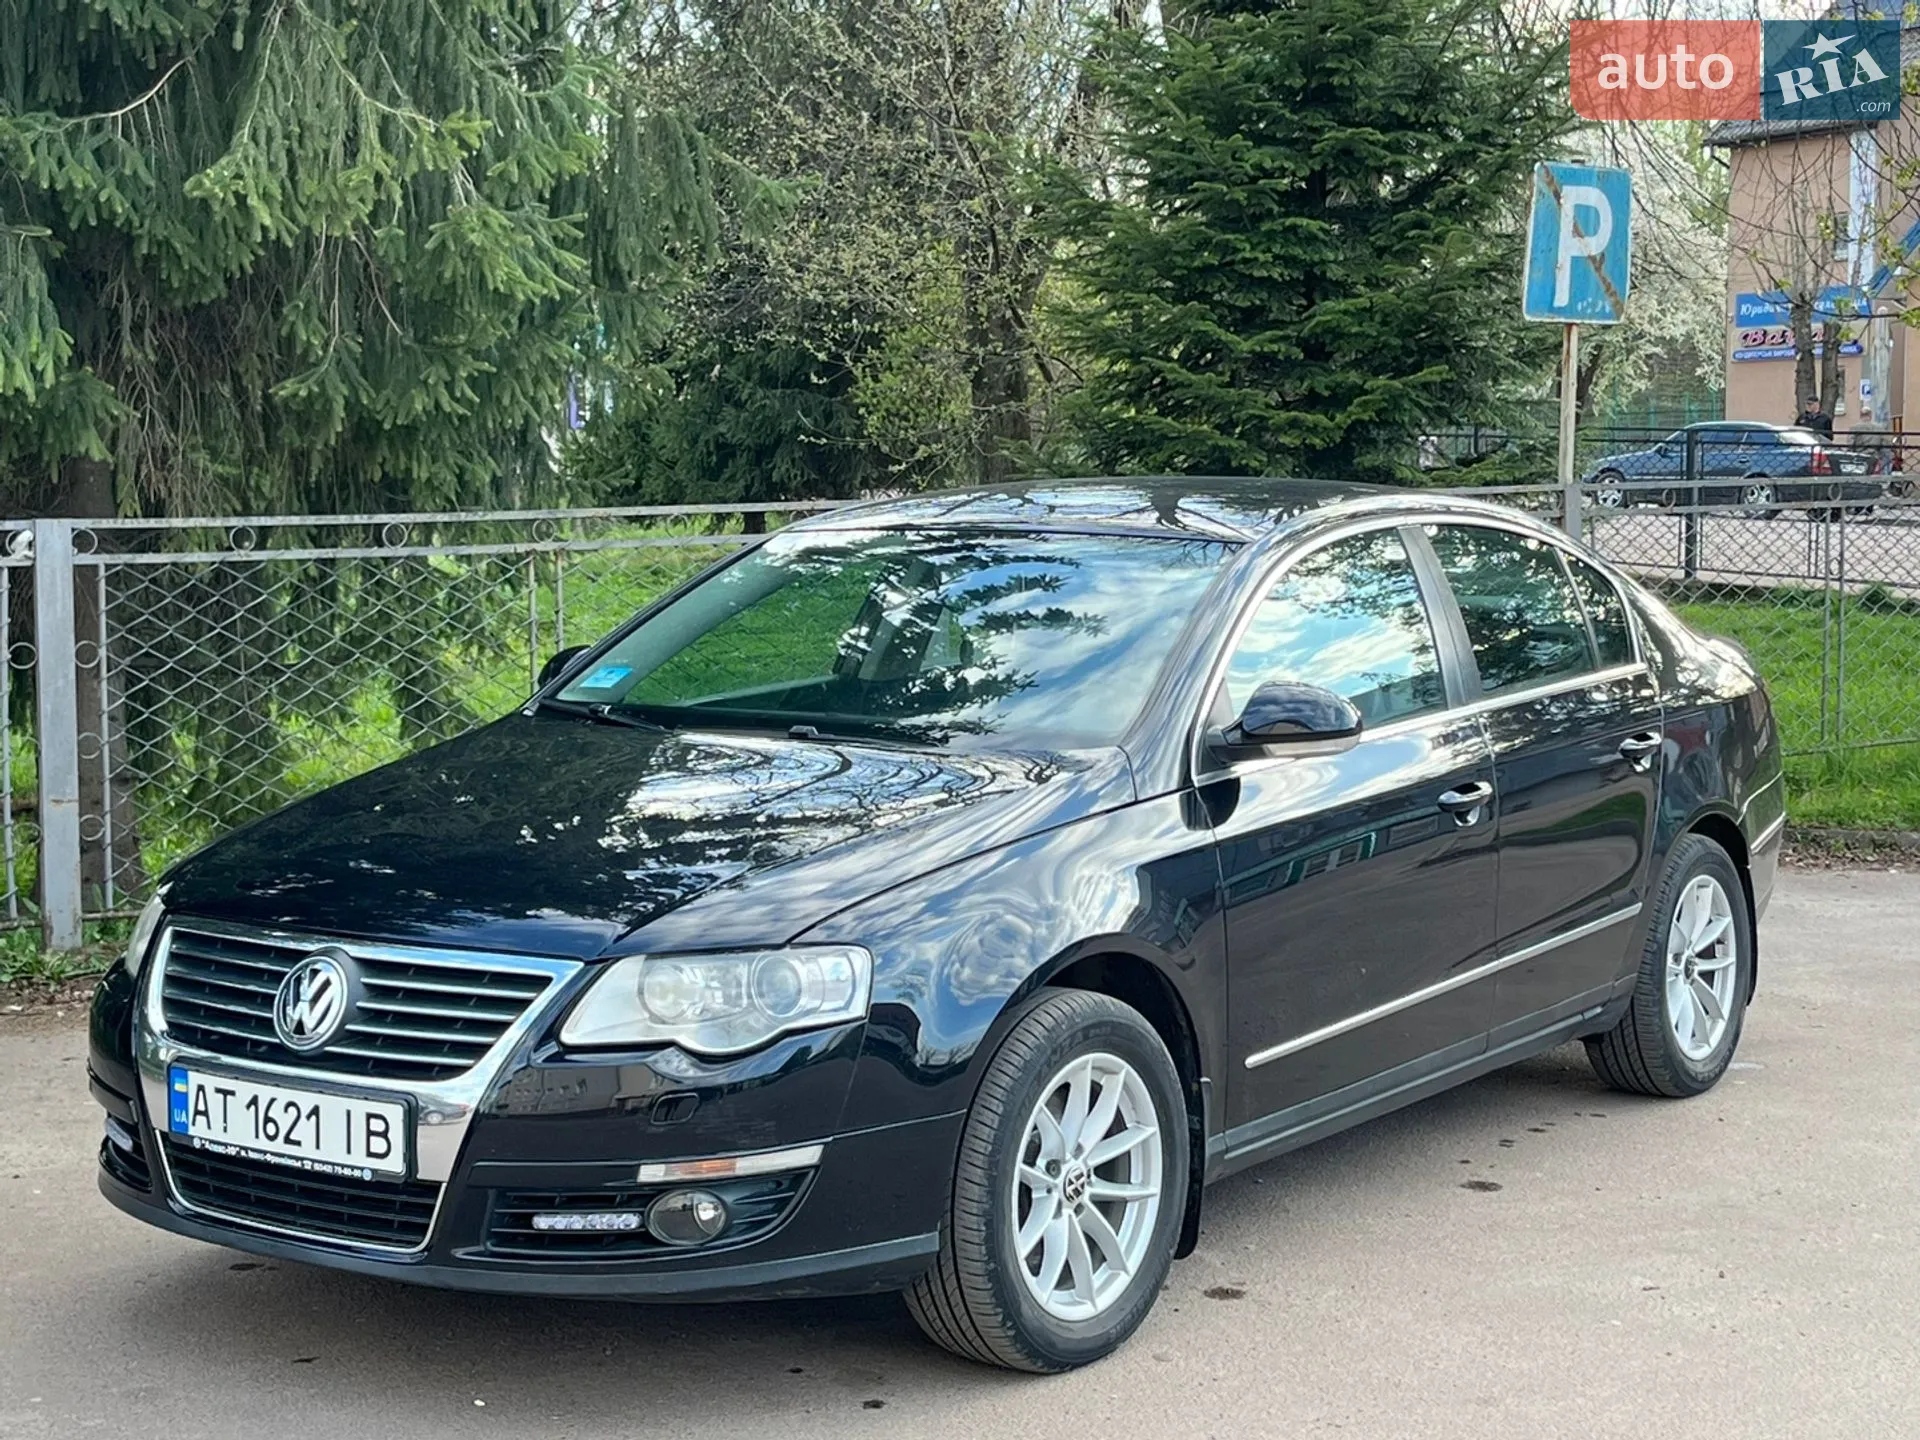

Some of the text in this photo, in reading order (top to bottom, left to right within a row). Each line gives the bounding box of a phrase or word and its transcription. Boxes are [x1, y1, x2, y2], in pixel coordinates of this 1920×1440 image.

[1552, 184, 1613, 308] P
[173, 1109, 188, 1124] UA
[191, 1083, 392, 1160] AT 1621 IB
